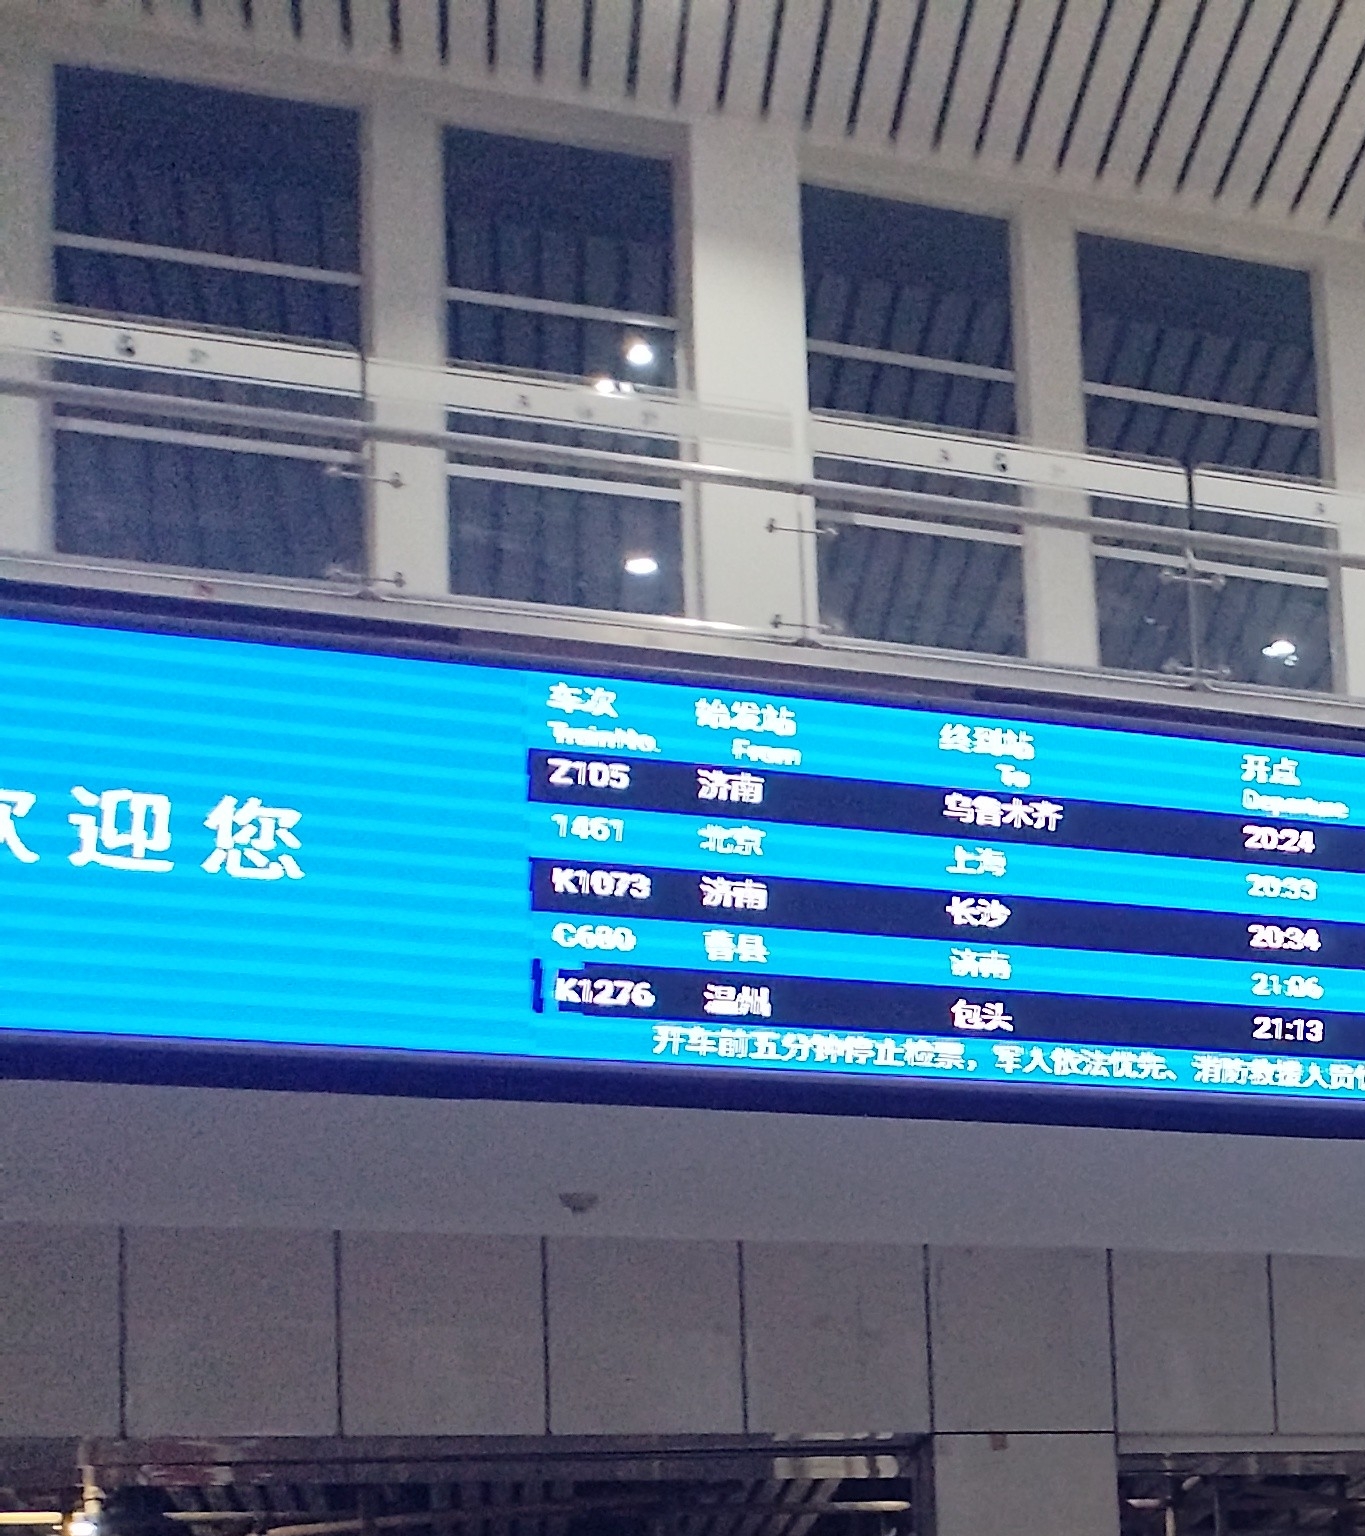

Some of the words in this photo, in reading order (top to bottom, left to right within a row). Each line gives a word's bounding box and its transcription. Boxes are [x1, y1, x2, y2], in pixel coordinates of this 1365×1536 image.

[548, 683, 617, 717] 车次
[696, 698, 797, 736] 始发站
[939, 723, 1035, 760] 终到站
[1241, 754, 1300, 786] 开点
[731, 738, 802, 766] From
[995, 764, 1031, 788] To
[547, 757, 630, 789] Z105
[697, 768, 765, 804] 济南
[942, 791, 1064, 832] 乌鲁木齐
[1242, 824, 1316, 854] 20:24
[551, 813, 624, 842] 1461
[698, 824, 766, 856] 北京
[946, 845, 1008, 876] 上海
[1245, 873, 1318, 901] 20:33
[551, 867, 651, 899] K1073
[699, 876, 768, 910] 济南
[945, 896, 1012, 928] 长沙
[1246, 924, 1322, 952] 20:34
[702, 929, 770, 963] 曹县
[949, 948, 1012, 980] 济南
[1251, 972, 1324, 999] 21:06
[555, 977, 656, 1007] K1276
[703, 982, 772, 1017] 温州
[950, 999, 1014, 1032] 包头
[1252, 1016, 1324, 1042] 21:13
